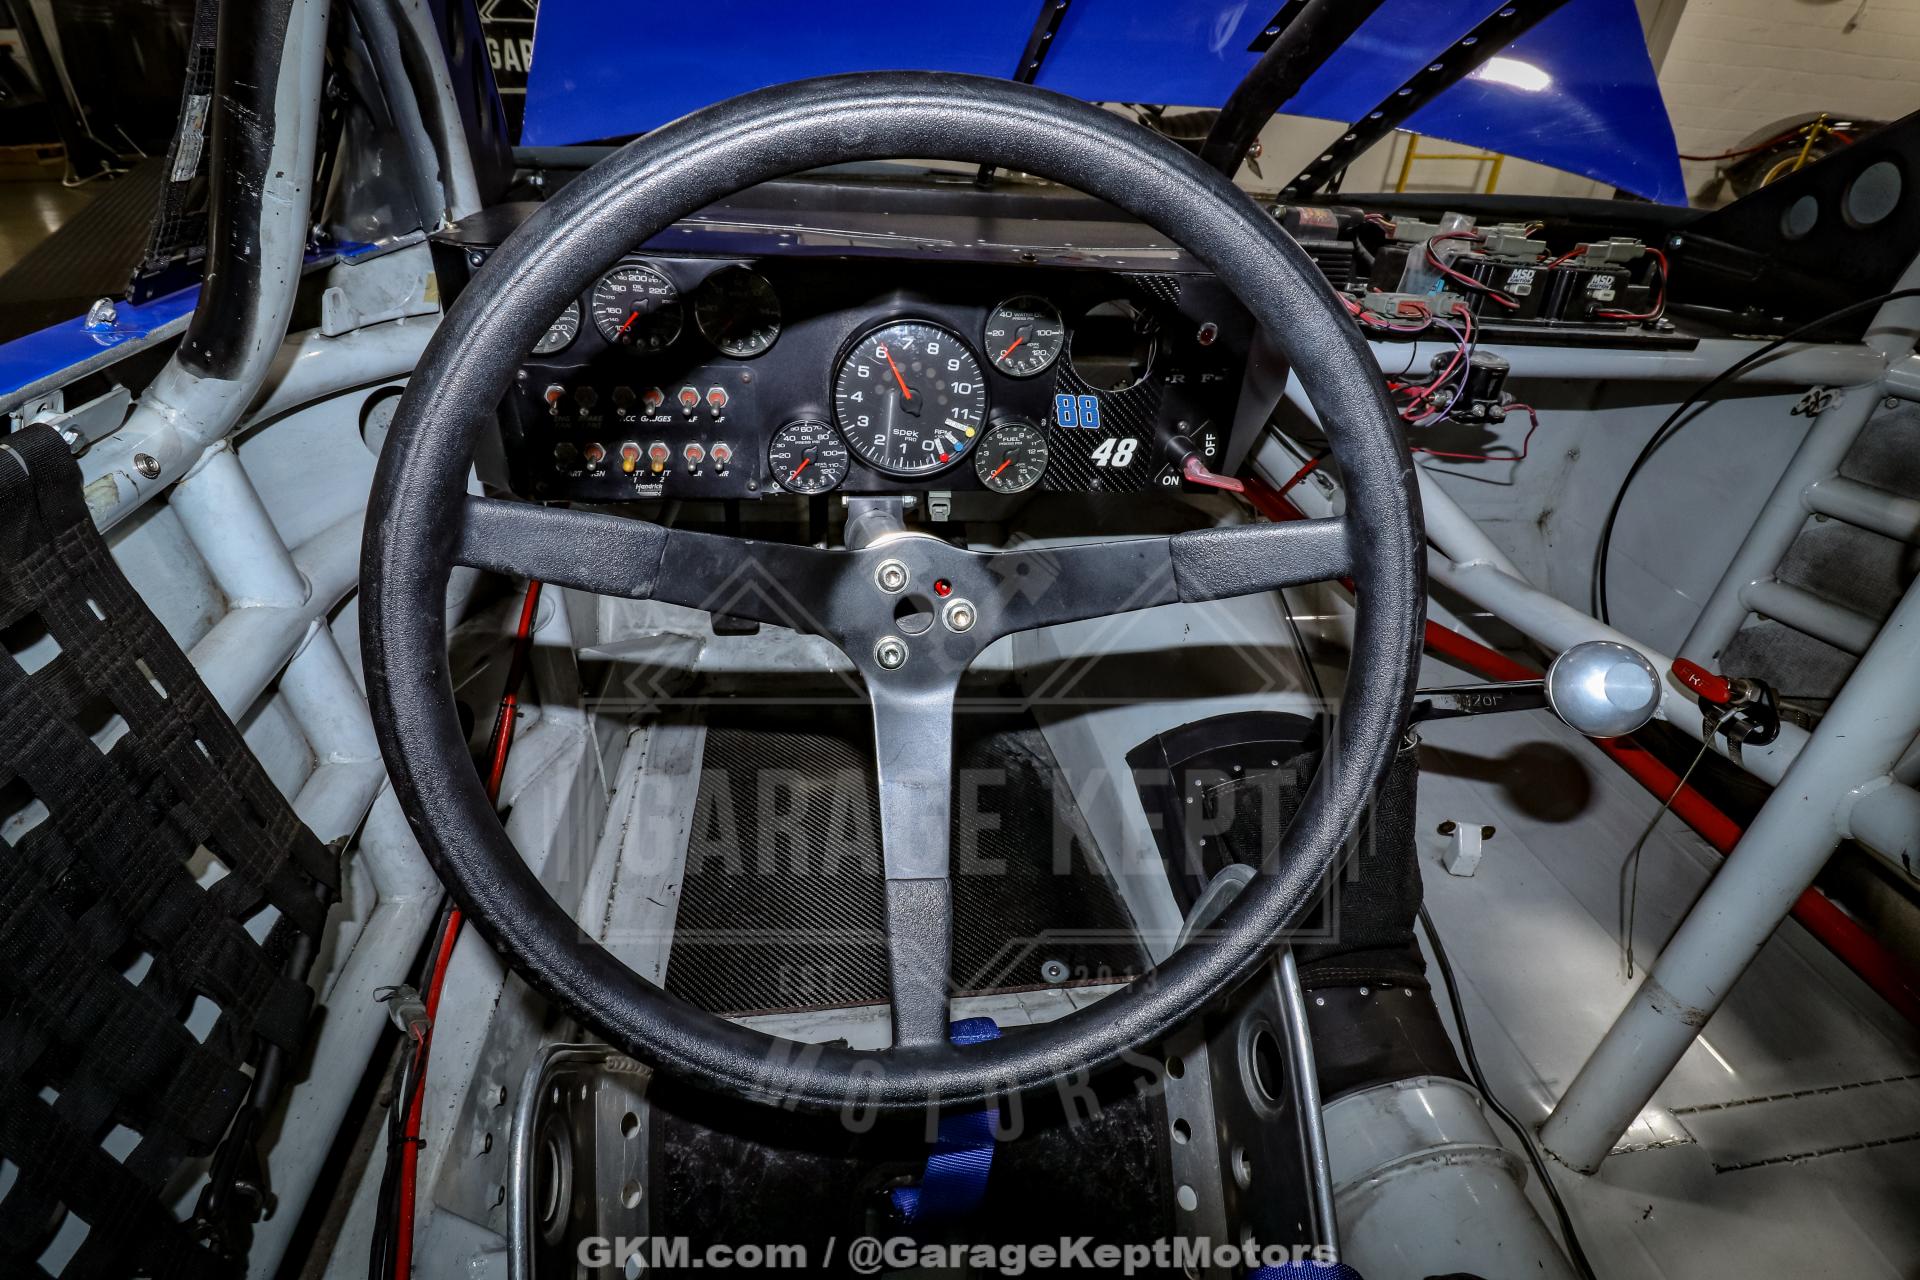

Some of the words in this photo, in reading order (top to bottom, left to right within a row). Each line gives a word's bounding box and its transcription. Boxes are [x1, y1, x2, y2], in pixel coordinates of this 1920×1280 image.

[1510, 269, 1536, 279] MSD
[1590, 274, 1616, 284] MSD
[902, 336, 914, 350] 7
[927, 343, 940, 355] 8
[875, 346, 888, 359] 6
[947, 359, 960, 371] 9
[857, 366, 870, 378] 5
[951, 382, 972, 395] 10
[850, 391, 863, 402] 4
[951, 408, 969, 420] 11
[1055, 393, 1101, 429] 88
[857, 416, 869, 427] 3
[893, 428, 919, 438] spek
[874, 434, 886, 446] 2
[921, 440, 935, 451] 0
[1205, 433, 1216, 457] OFF
[899, 443, 907, 454] 1
[1091, 438, 1138, 467] 48
[1162, 475, 1180, 486] ON
[635, 483, 663, 492] Hendrick
